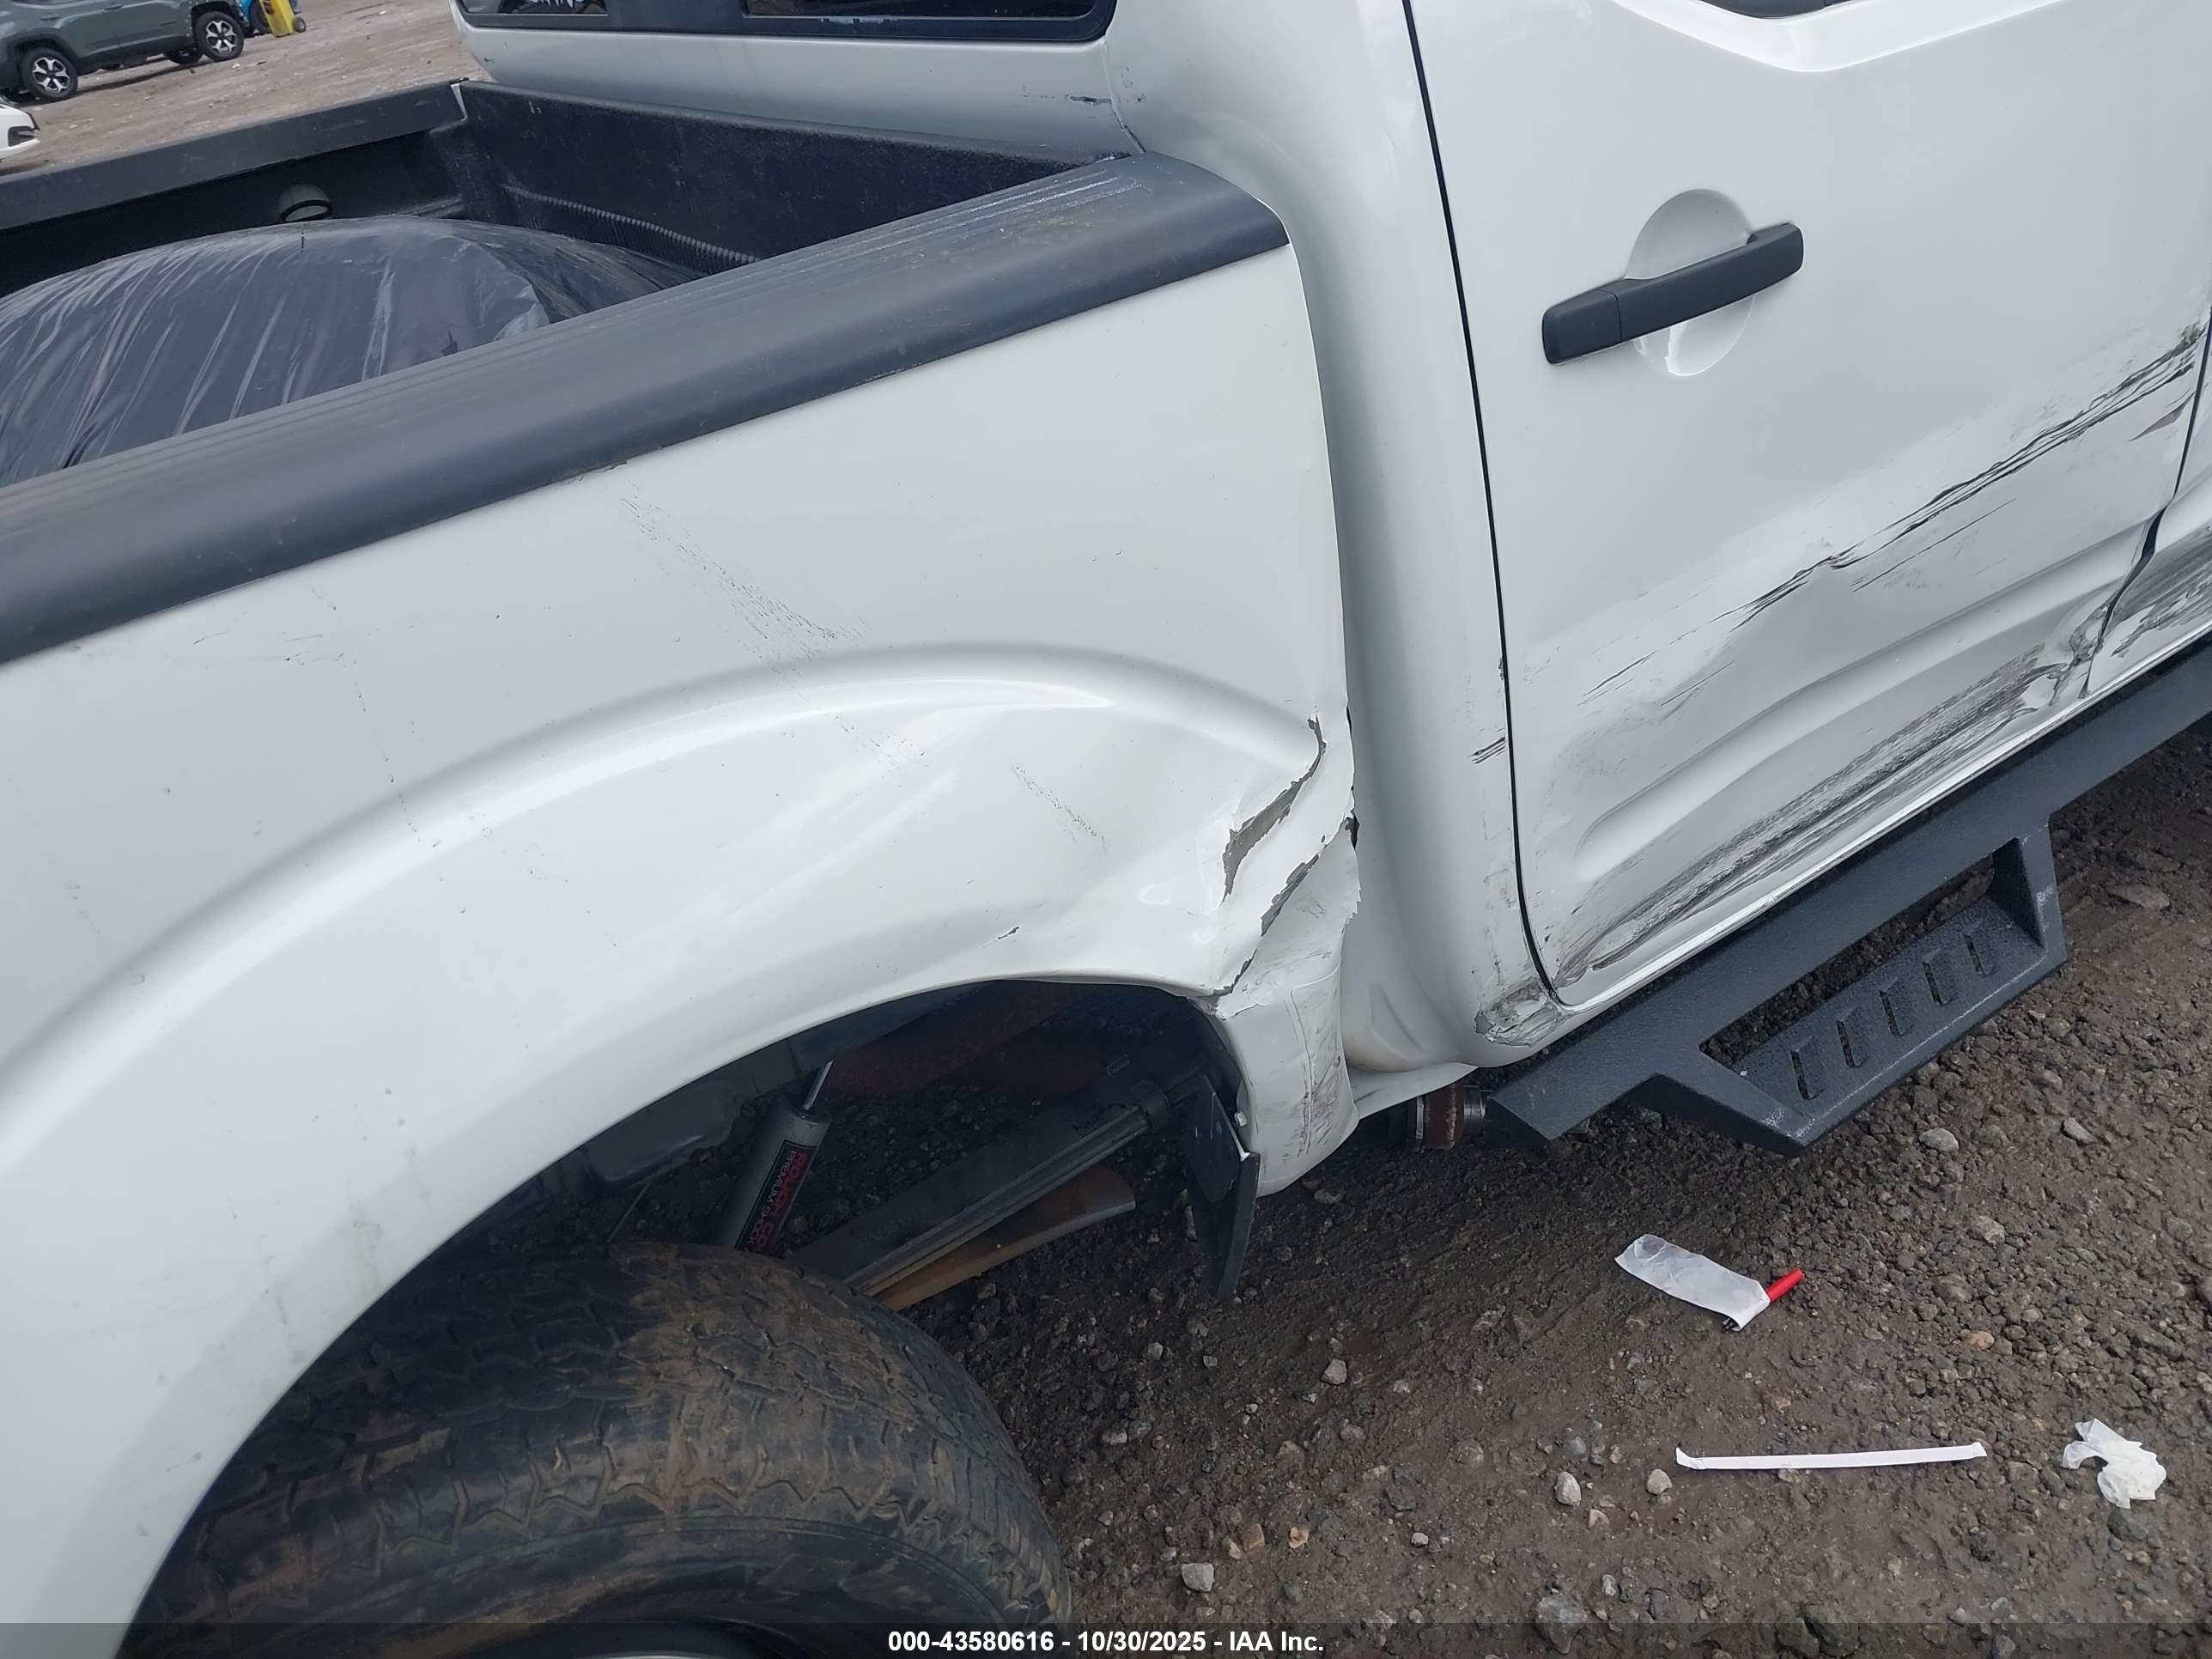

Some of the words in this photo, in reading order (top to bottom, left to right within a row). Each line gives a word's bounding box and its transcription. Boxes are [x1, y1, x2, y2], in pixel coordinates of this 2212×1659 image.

[766, 1150, 797, 1203] PREMIUM
[769, 1152, 807, 1217] ROUGH
[747, 1206, 770, 1244] SHOCK
